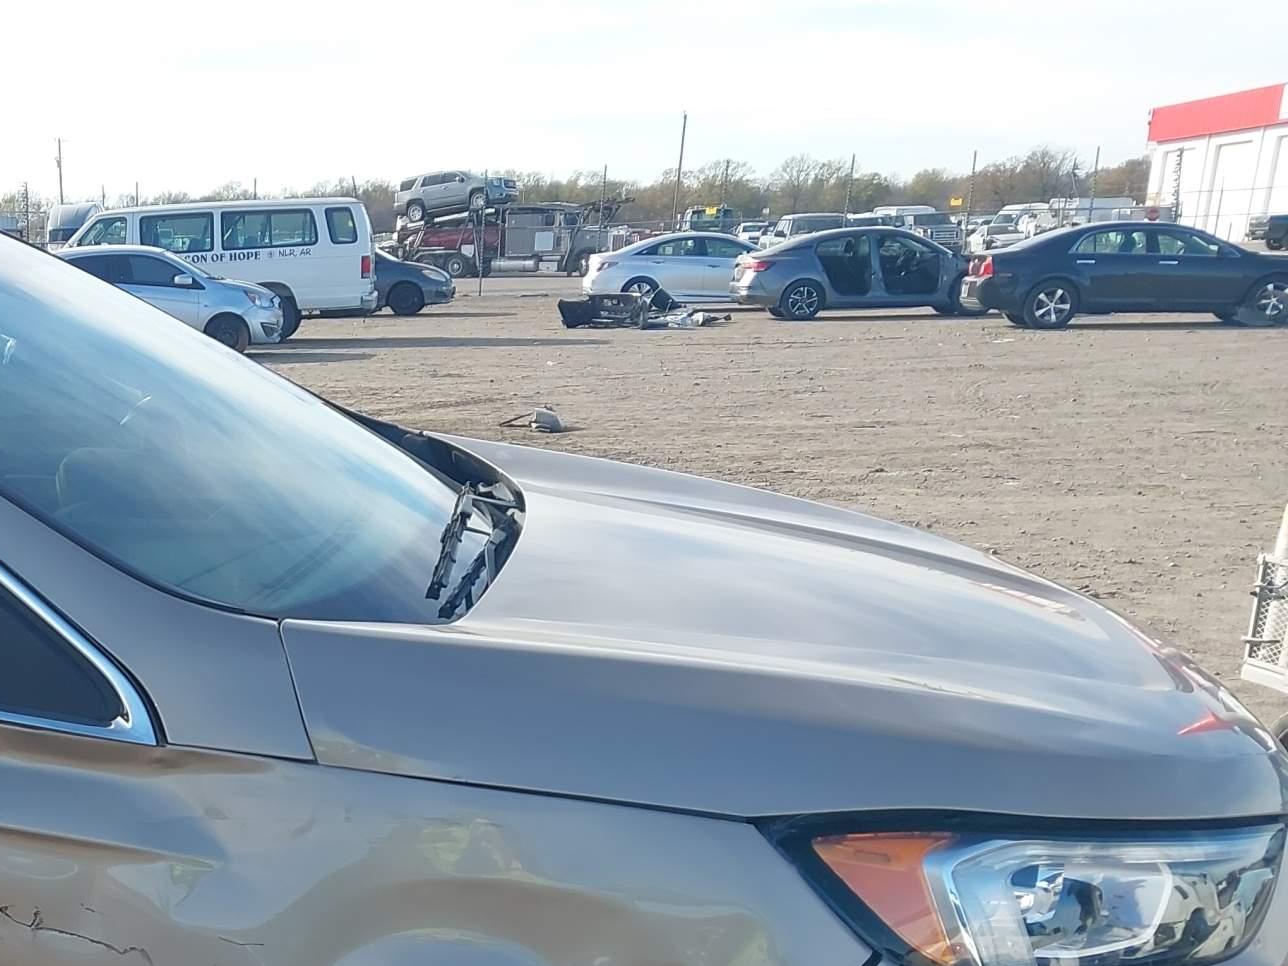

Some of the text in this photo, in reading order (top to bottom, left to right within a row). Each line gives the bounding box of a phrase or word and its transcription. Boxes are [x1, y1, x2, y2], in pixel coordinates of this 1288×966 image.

[211, 253, 225, 262] OF
[229, 251, 261, 261] HOPE
[300, 248, 312, 256] AR
